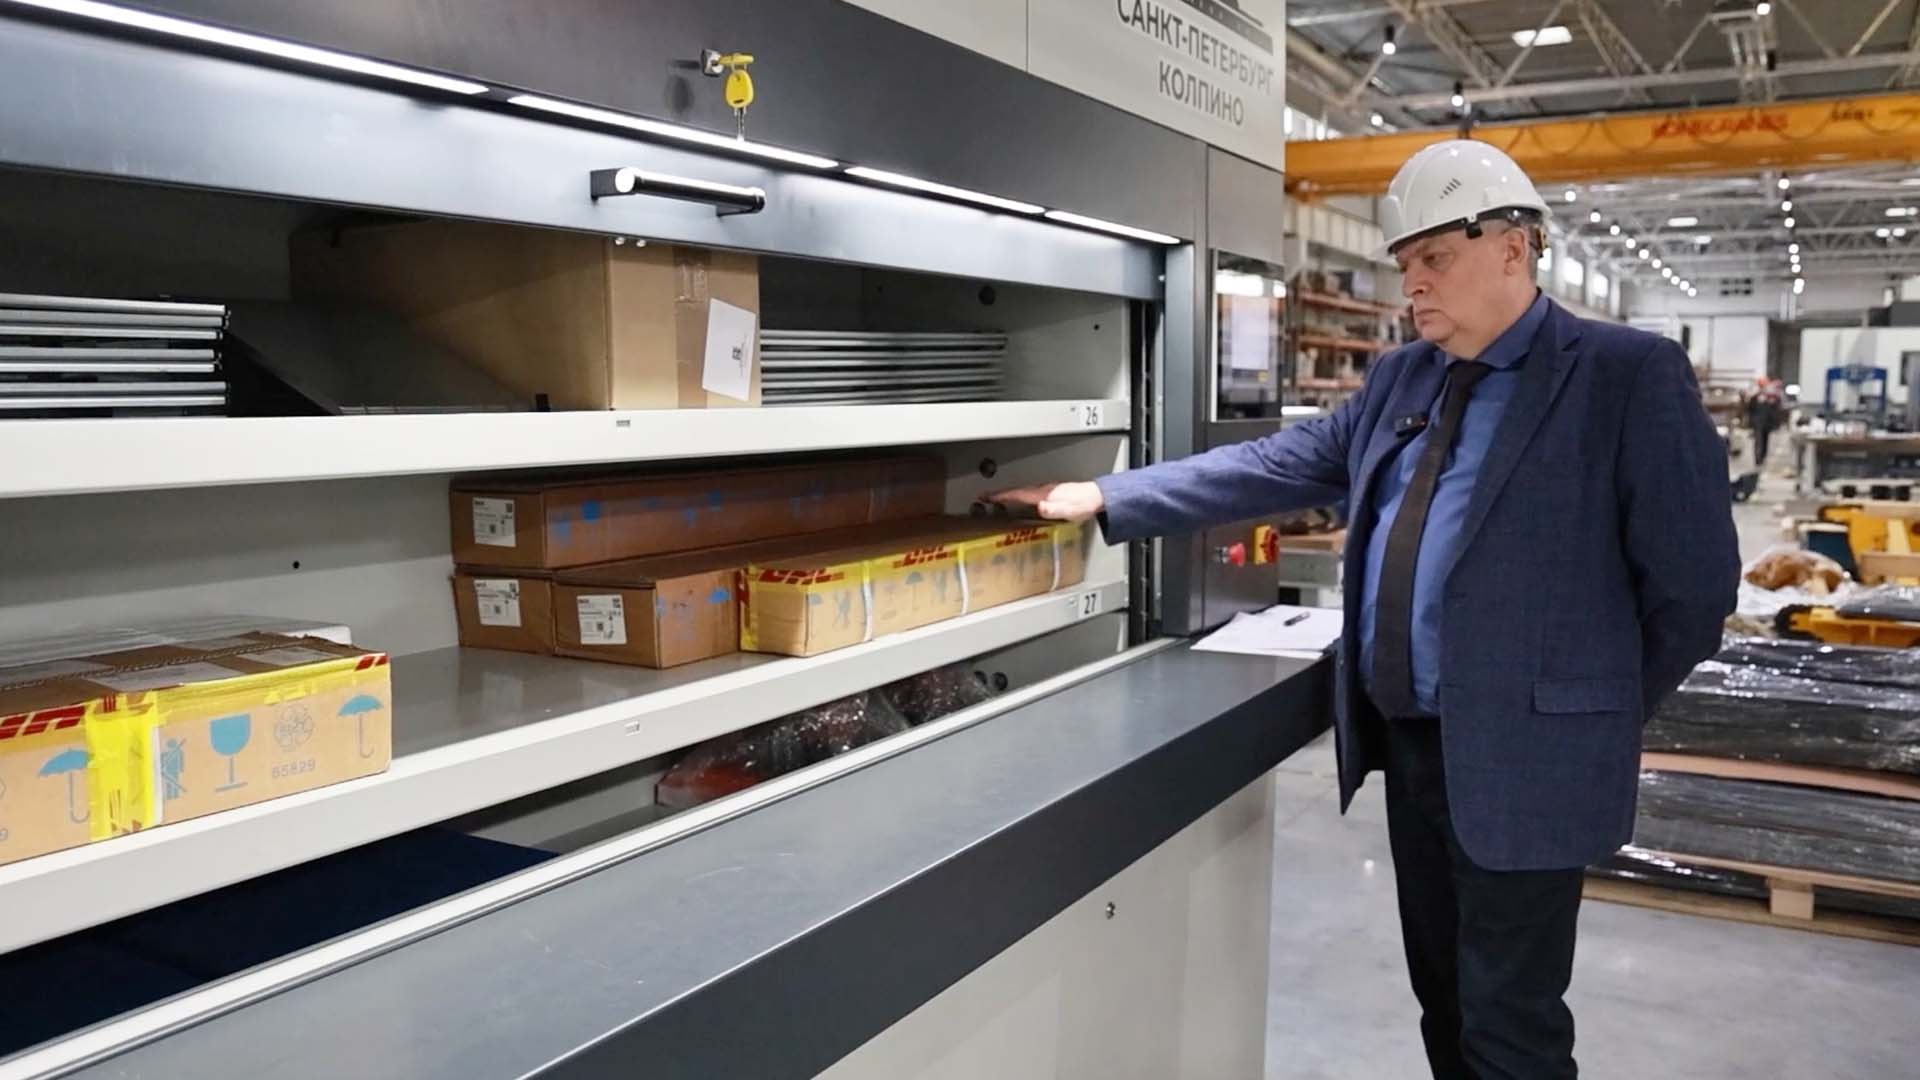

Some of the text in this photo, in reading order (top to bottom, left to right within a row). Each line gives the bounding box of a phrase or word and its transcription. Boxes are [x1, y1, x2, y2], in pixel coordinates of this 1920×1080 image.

[1117, 0, 1274, 94] САНКТ-ПЕТЕРБУРГ
[1159, 60, 1245, 126] КОЛПИНО
[1085, 405, 1098, 426] 26
[1084, 592, 1097, 615] 27
